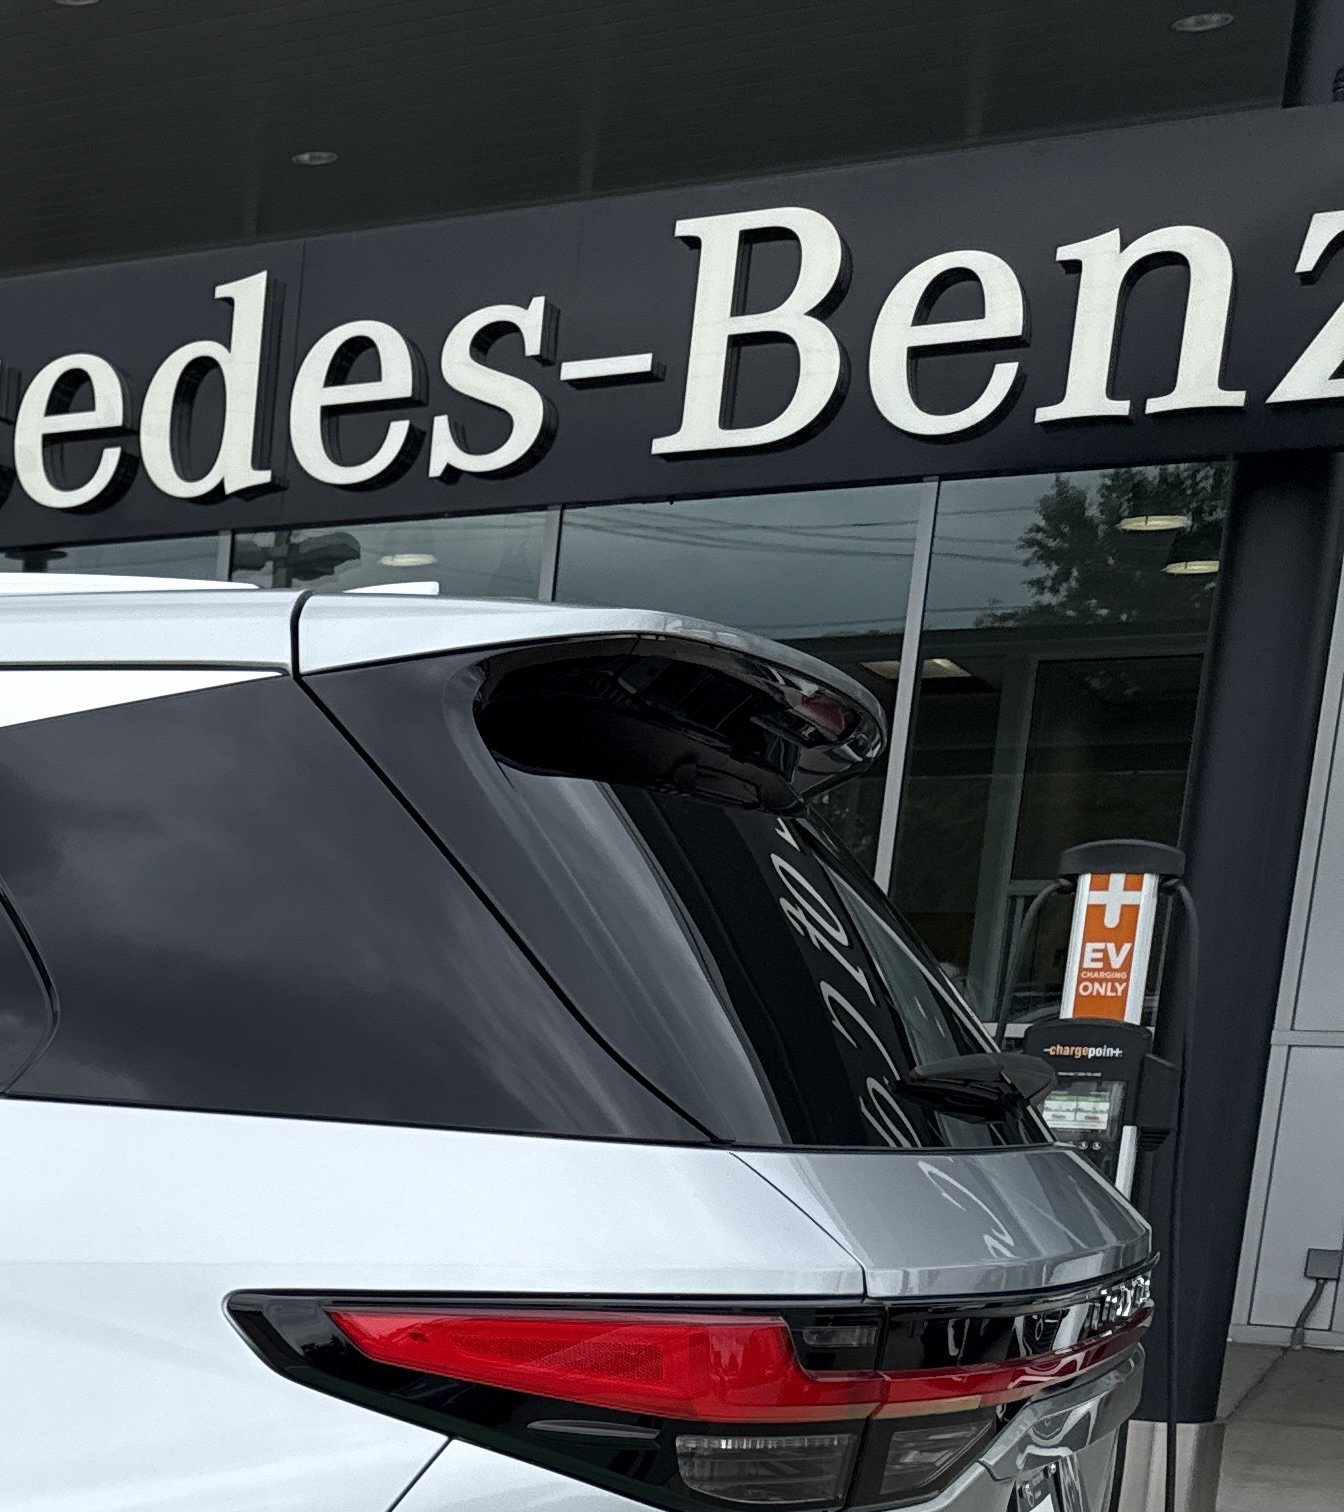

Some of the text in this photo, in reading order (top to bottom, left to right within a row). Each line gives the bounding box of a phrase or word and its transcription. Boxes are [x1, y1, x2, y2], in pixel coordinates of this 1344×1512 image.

[1082, 942, 1133, 969] EV
[1080, 970, 1127, 980] CHARGING
[1078, 981, 1127, 997] ONLY
